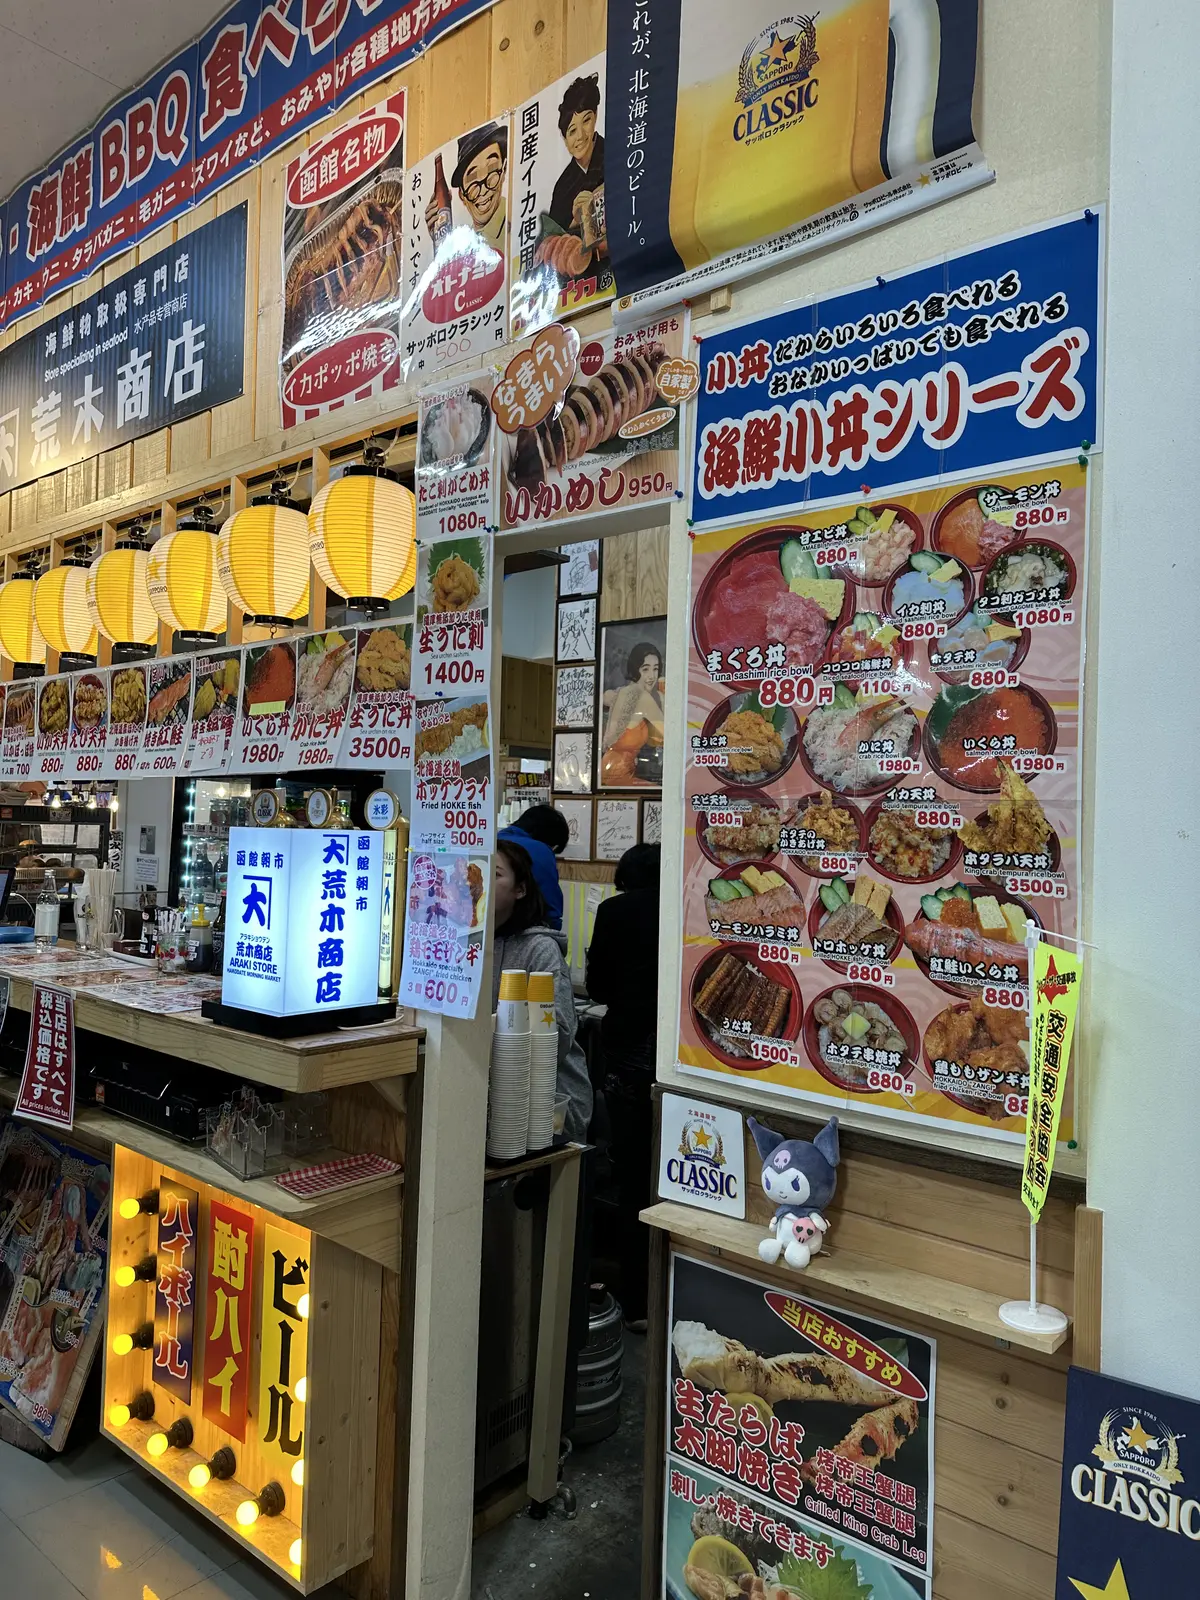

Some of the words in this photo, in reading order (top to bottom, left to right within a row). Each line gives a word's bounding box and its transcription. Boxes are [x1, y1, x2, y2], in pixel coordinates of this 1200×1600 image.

[760, 21, 779, 39] SINCE
[780, 16, 795, 27] 1985
[760, 61, 793, 83] SAPPORO
[752, 86, 767, 100] ONLY
[767, 73, 800, 90] HOKKAIDO
[733, 78, 819, 142] CLASSIC
[100, 70, 190, 208] BBQ
[745, 115, 804, 146] サッポロクラシック
[299, 122, 387, 204] 函館名物
[517, 101, 539, 275] 国産イカ使用
[45, 253, 189, 358] 海鮮物取扱専門店
[406, 304, 504, 356] サッポロクラシック
[495, 328, 503, 340] 円
[614, 318, 679, 349] おみやげ用も
[707, 342, 770, 392] 小丼
[776, 273, 1019, 362] だからいろいろ食べれる
[44, 366, 59, 382] Store
[60, 347, 95, 376] specializing
[95, 343, 101, 355] in
[102, 327, 128, 350] seafood
[436, 338, 472, 364] 500
[770, 296, 1068, 397] おなかいっぱいでも食べれる
[284, 337, 398, 402] イカポッポ焼き
[495, 340, 554, 406] なまら
[660, 373, 693, 389] 自家製
[30, 319, 206, 468] 荒木商店
[703, 336, 1080, 492] 海鮮小丼シリーズ
[505, 467, 625, 525] いかめし
[629, 471, 673, 498] 950円
[985, 481, 1061, 506] サーモン丼
[991, 503, 1015, 513] Salmon
[1015, 507, 1068, 527] 880円
[439, 511, 486, 533] 1080円
[816, 547, 857, 565] 880円
[1015, 608, 1072, 627] 1080円
[419, 621, 484, 654] 生うに刺
[903, 622, 946, 638] 880円
[706, 643, 786, 672] まぐろ丼
[931, 650, 977, 665] ホタテ丼
[424, 660, 485, 684] 1400円
[711, 672, 732, 682] Tuna
[734, 669, 767, 680] sashimi
[769, 668, 788, 677] rice
[790, 666, 813, 676] bowl
[971, 670, 1017, 686] 880円
[761, 678, 833, 706] 880円
[242, 711, 291, 737] いくら丼
[290, 706, 346, 742] かに丼
[349, 702, 413, 729] 生うに丼
[69, 726, 107, 749] えび天丼
[349, 737, 411, 759] 3500円
[858, 741, 894, 753] かに丼
[963, 735, 1016, 750] いくら丼
[153, 757, 177, 770] 600円
[298, 748, 333, 765] 1980円
[695, 754, 727, 765] 3500円
[878, 760, 920, 772] 1980円
[1014, 758, 1064, 771] 1980円
[17, 763, 30, 775] 700
[416, 777, 489, 800] ホッケフライ
[887, 788, 935, 800] イカ天丼
[421, 802, 439, 810] Fried
[468, 802, 482, 810] fish
[444, 810, 487, 830] 900円
[709, 813, 742, 825] 880円
[917, 812, 961, 826] 880円
[450, 831, 484, 846] 500円
[236, 850, 284, 870] 函館朝市
[821, 858, 856, 871] 880円
[355, 835, 370, 912] 函館朝市
[964, 867, 980, 876] King
[982, 868, 998, 876] crab
[999, 869, 1030, 878] tempura
[1009, 878, 1065, 895] 3500円
[315, 869, 347, 1004] 荒木商店
[710, 920, 800, 941] サーモンハラミ丼
[236, 941, 273, 962] 荒木商店
[759, 946, 799, 963] 880円
[813, 939, 887, 958] トロホッケ丼
[229, 957, 251, 970] ARAKI
[252, 961, 278, 975] STORE
[849, 965, 893, 984] 880円
[930, 958, 1019, 981] 紅鮭いくら丼
[425, 979, 469, 1006] 600円
[722, 1018, 752, 1032] うな丼
[31, 991, 53, 1100] 税込価格です
[50, 995, 68, 1106] 当店はすべて
[753, 1043, 799, 1065] 1500円
[827, 1042, 901, 1066] ホタテ串焼丼
[869, 1071, 914, 1094] 880円
[933, 1082, 948, 1091] fried
[948, 1084, 974, 1096] chicken
[973, 1088, 988, 1097] rice
[988, 1091, 1004, 1101] bowl
[934, 1075, 967, 1086] HOKKAIDO
[28, 1100, 43, 1111] prices
[44, 1104, 61, 1115] include
[693, 1146, 712, 1156] SAPPORO
[667, 1158, 737, 1199] CLASSIC
[682, 1186, 722, 1201] サッポロクラシック
[156, 1192, 192, 1379] ハイボール
[208, 1216, 249, 1417] 酎ハイ
[263, 1249, 309, 1457] ビール
[781, 1298, 902, 1387] 当店おすすめ
[674, 1378, 804, 1464] 生たらば
[1123, 1406, 1142, 1415] SINCE
[1143, 1410, 1157, 1422] 1985
[1119, 1449, 1156, 1468] SAPPORO
[816, 1446, 916, 1511] 烤帝王蟹腿
[1129, 1464, 1161, 1482] HOKKAIDO
[815, 1471, 916, 1537] 烤帝王蟹腿
[1071, 1463, 1200, 1541] CLASSIC
[671, 1470, 836, 1569] 刺し・焼きできます
[805, 1494, 840, 1523] Grilled
[842, 1512, 869, 1537] King
[871, 1528, 900, 1551] Crab
[903, 1541, 926, 1564] Leg
